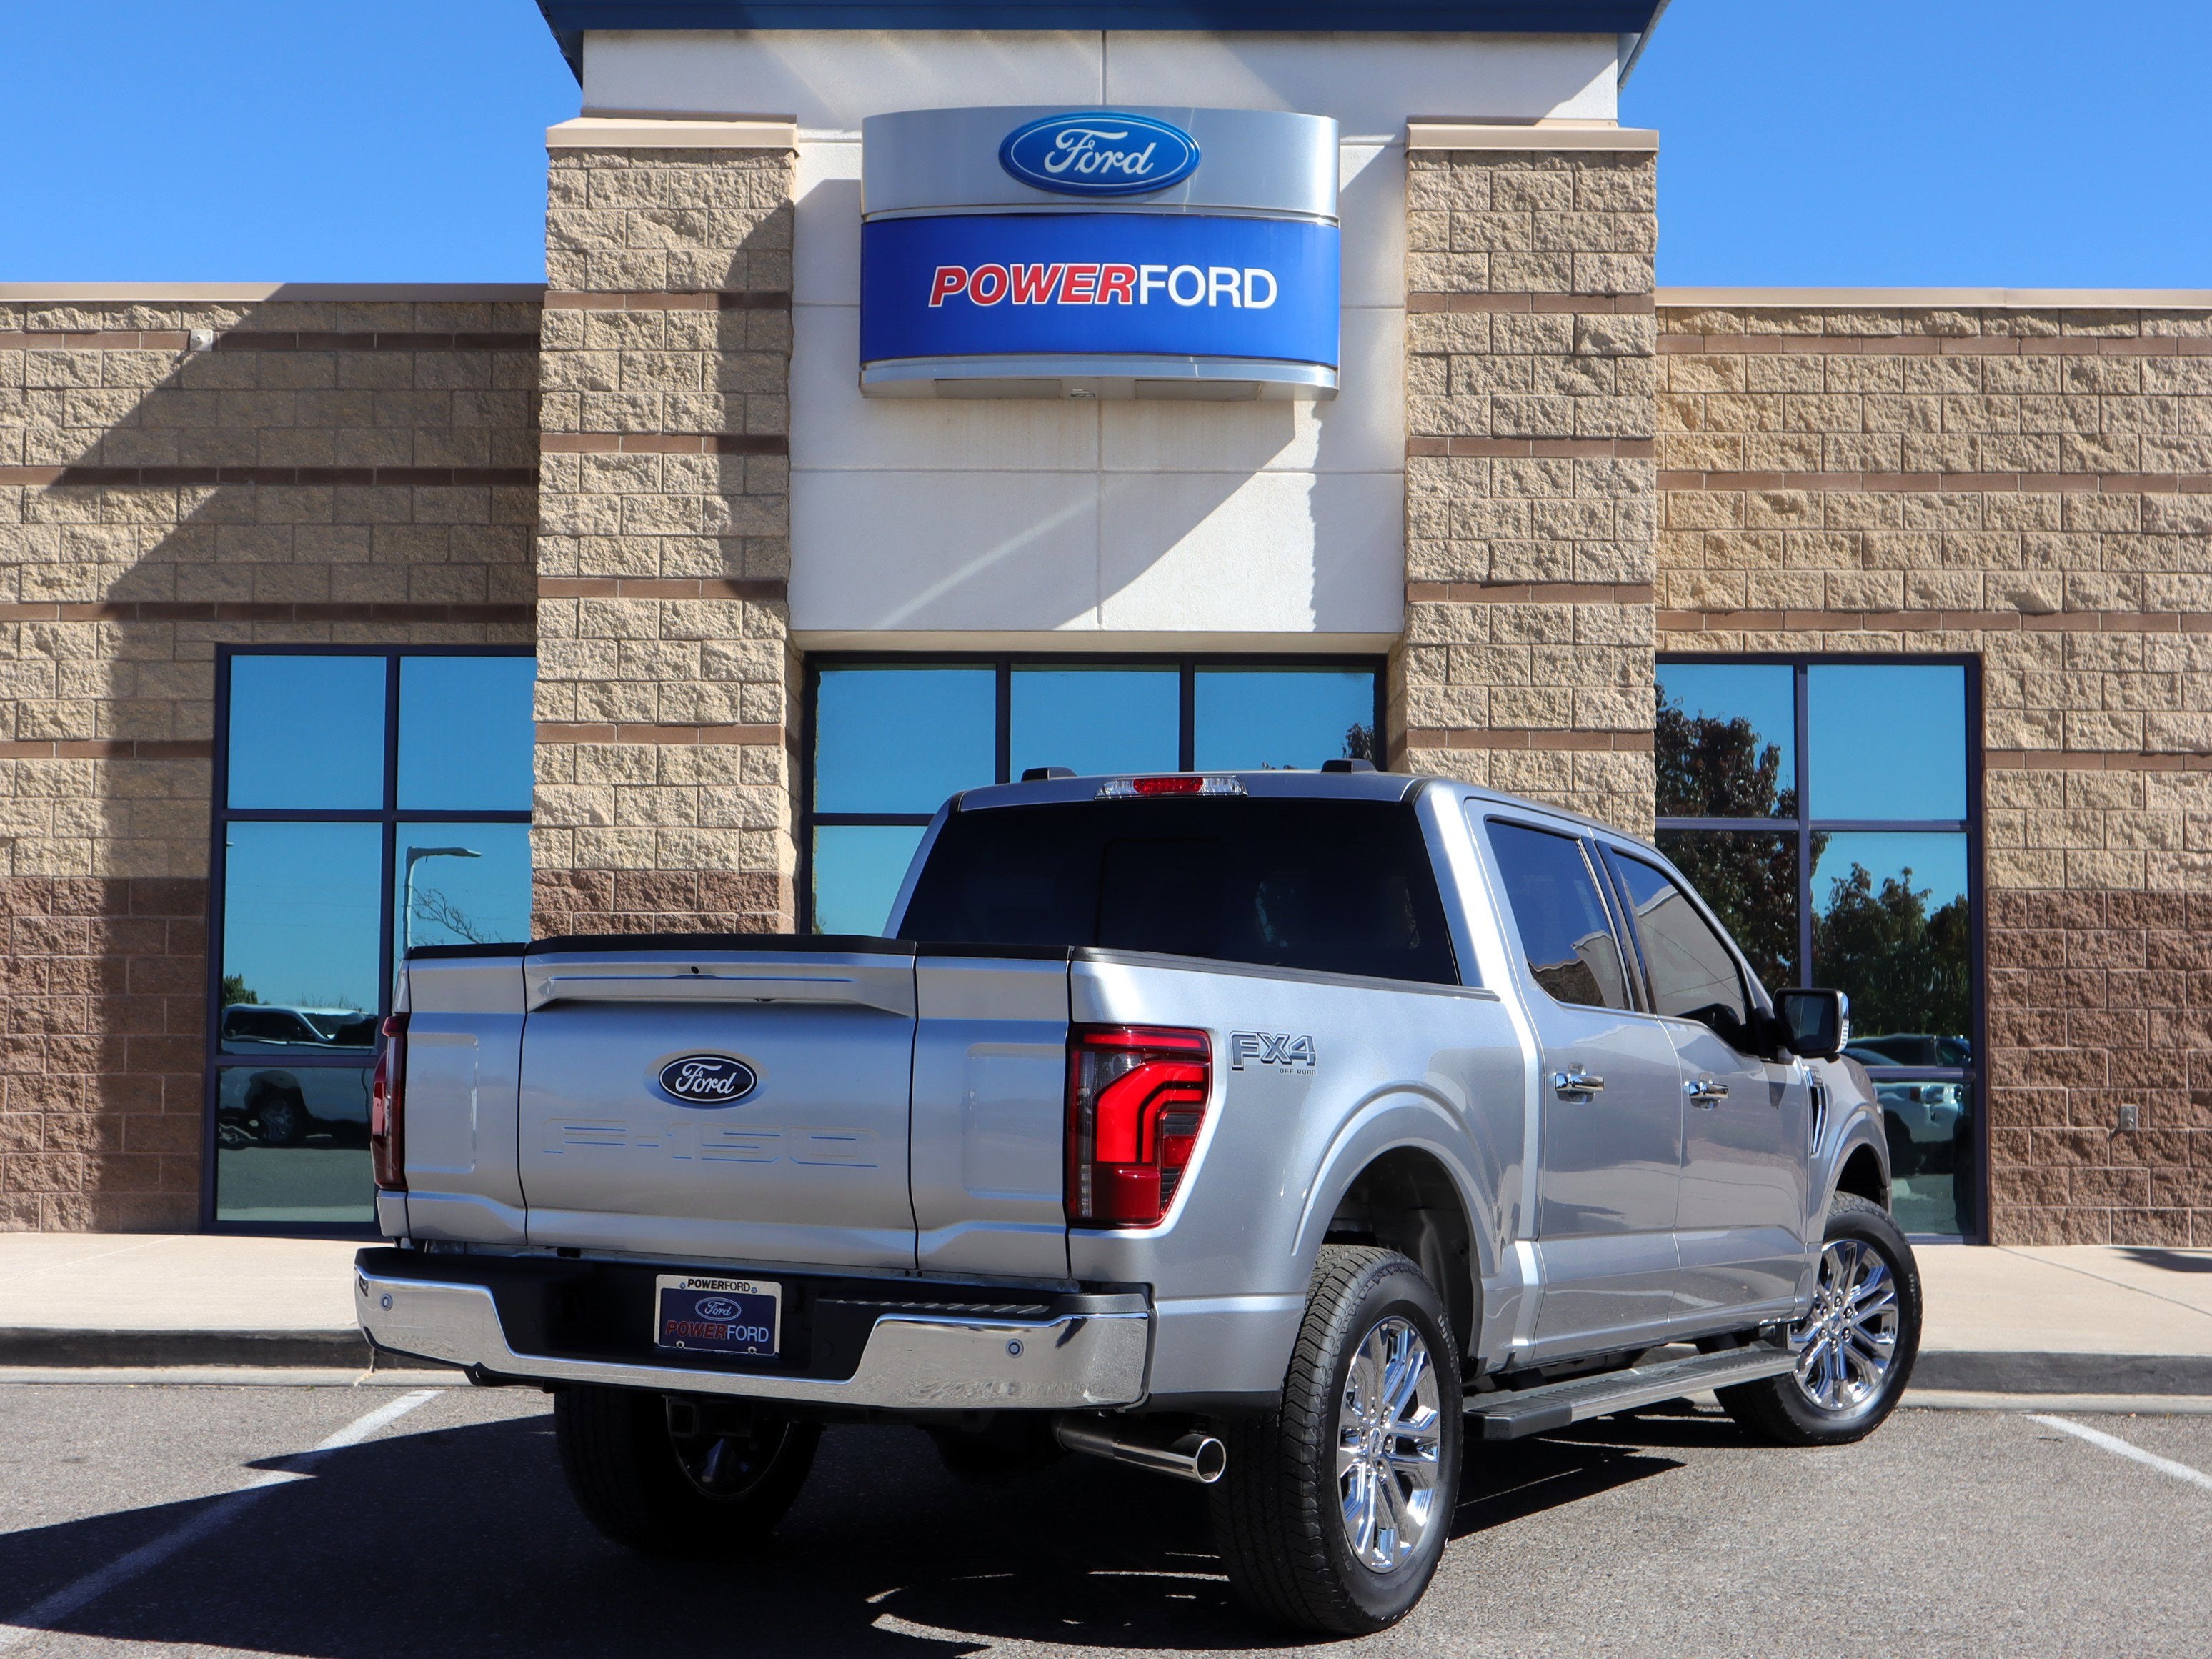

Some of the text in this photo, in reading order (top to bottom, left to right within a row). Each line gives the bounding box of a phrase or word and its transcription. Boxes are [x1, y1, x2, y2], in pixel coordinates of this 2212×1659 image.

[1043, 127, 1155, 176] Ford
[928, 263, 1277, 309] POWERFORD
[1229, 1030, 1316, 1070] FX4
[675, 1062, 737, 1095] Ford
[687, 1278, 751, 1292] POWERFORD
[704, 1300, 732, 1317] Ford
[664, 1320, 769, 1343] POWERFORD
